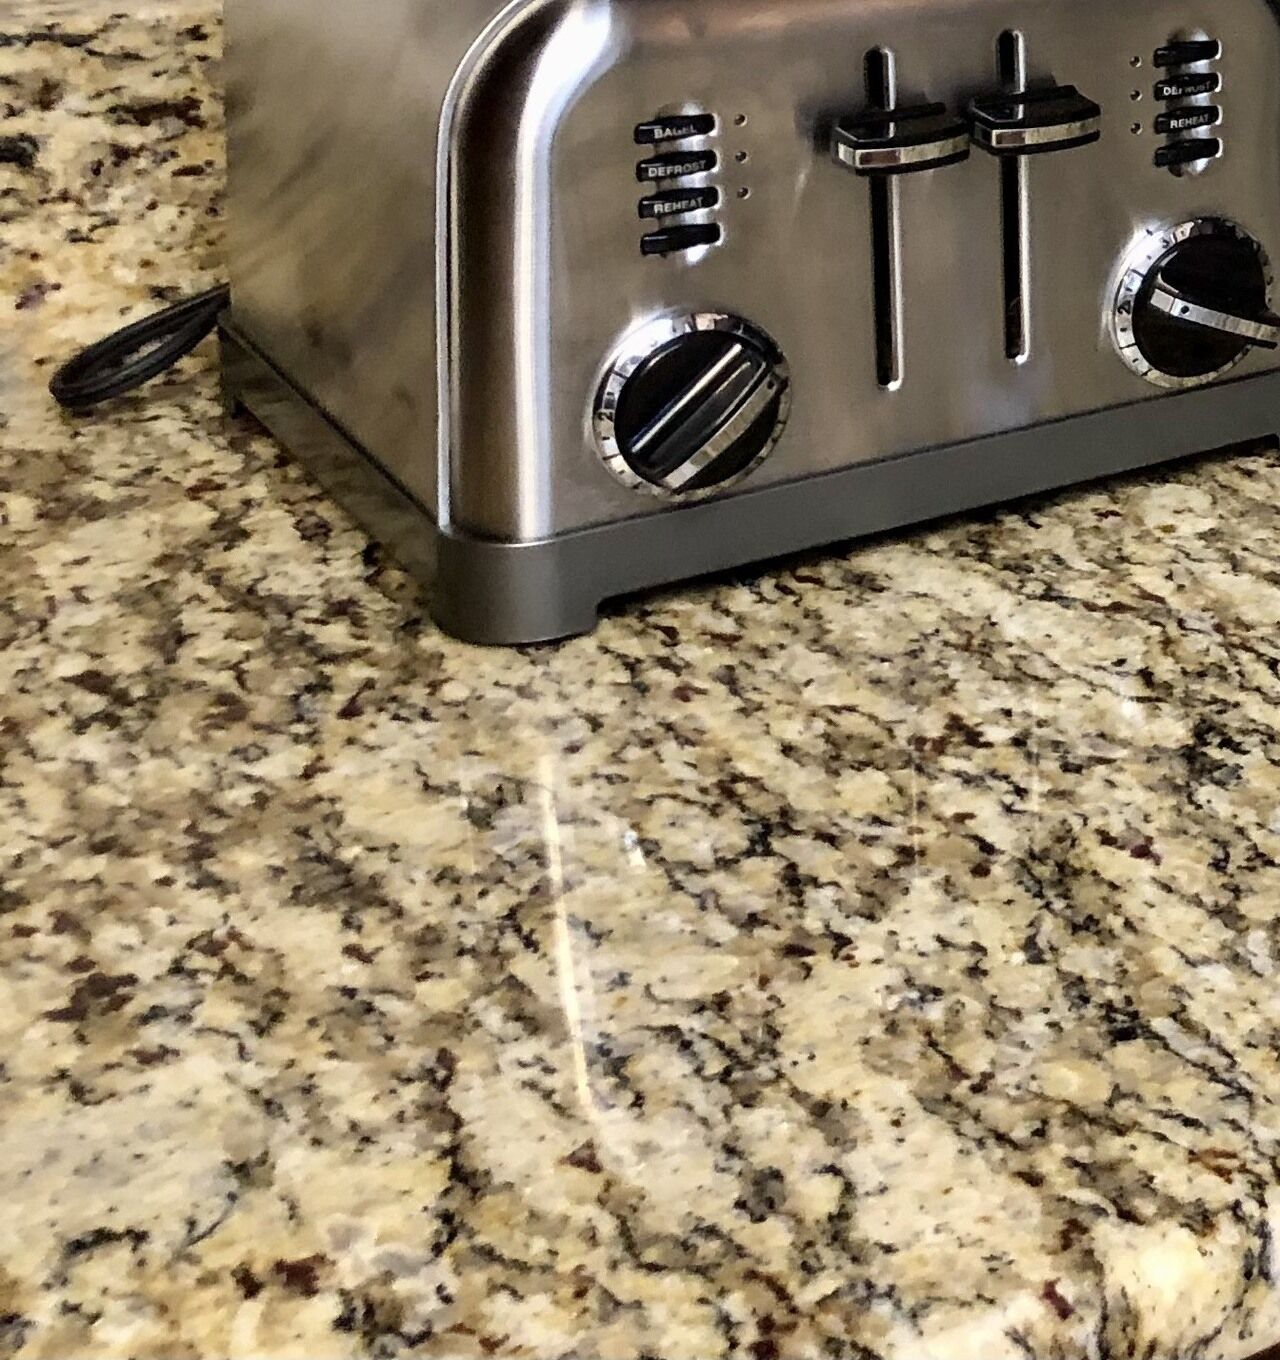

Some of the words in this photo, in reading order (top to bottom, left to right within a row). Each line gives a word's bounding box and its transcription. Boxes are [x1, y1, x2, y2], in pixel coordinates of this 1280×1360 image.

[1170, 114, 1209, 129] REHEAT
[648, 160, 706, 177] DEFROST
[654, 197, 703, 214] REHEAT
